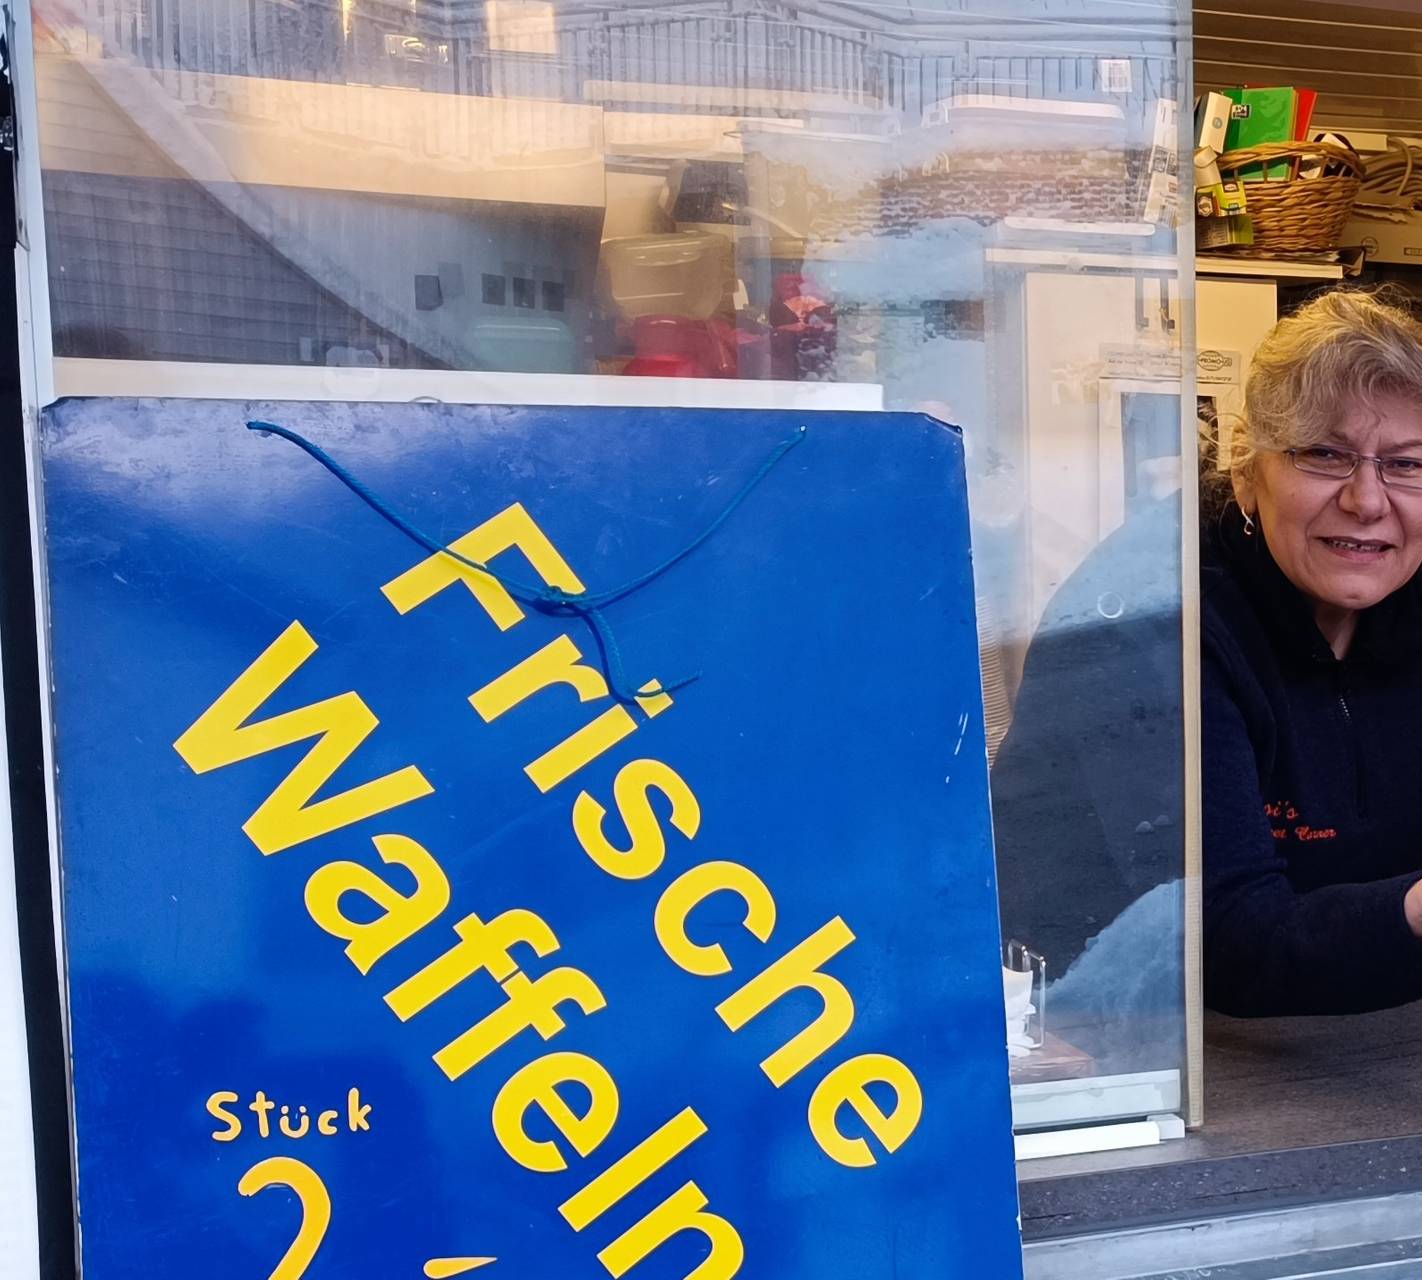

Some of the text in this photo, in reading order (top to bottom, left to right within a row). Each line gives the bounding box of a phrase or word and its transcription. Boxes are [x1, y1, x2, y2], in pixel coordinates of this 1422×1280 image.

[171, 620, 746, 1280] Waffeln
[206, 1087, 373, 1142] Stück
[380, 502, 924, 1169] Frische
